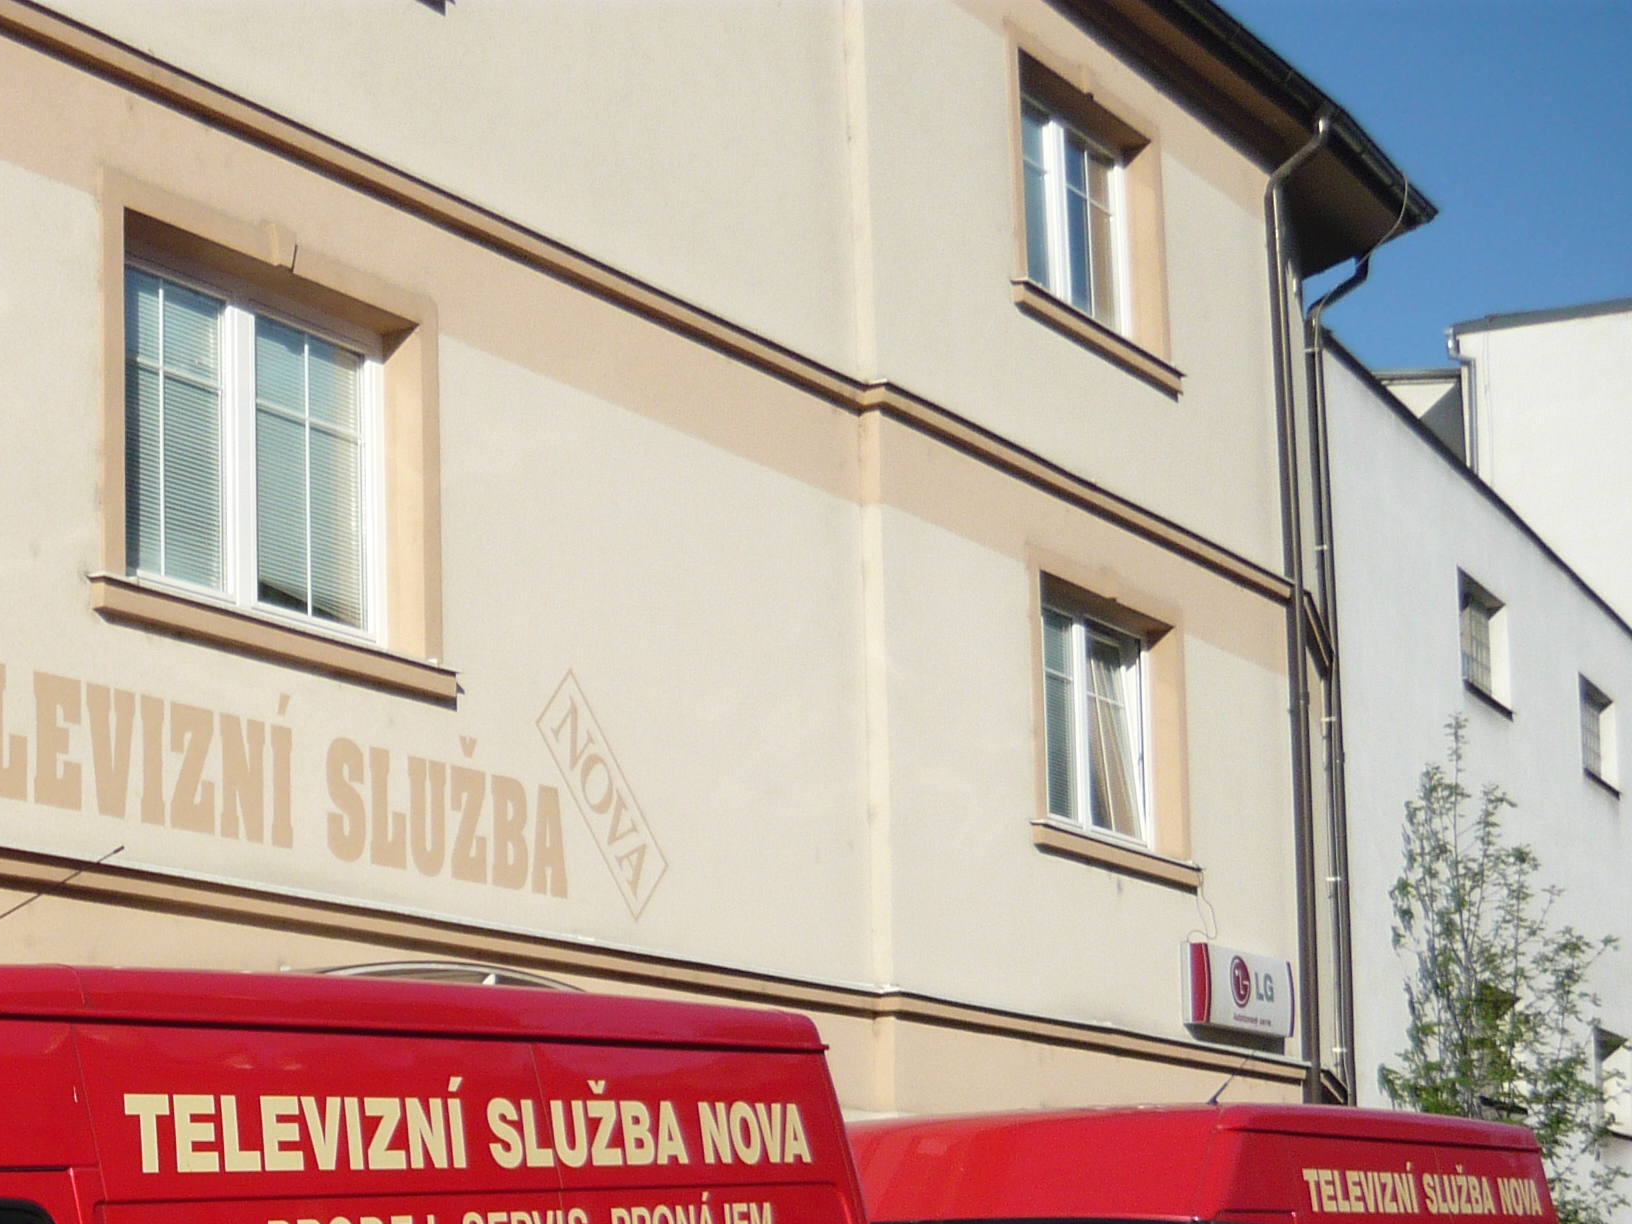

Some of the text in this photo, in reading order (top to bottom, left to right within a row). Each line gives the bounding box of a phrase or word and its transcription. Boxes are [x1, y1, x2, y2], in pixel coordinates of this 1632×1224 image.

[324, 735, 570, 899] SLUŽBA
[551, 694, 647, 901] NOVA
[1254, 971, 1274, 1003] LG
[124, 1076, 812, 1173] TELEVIZNÍ SLUŽBA NOVA
[1302, 1162, 1543, 1216] TELEVIZNÍ SLUŽBA NOVA
